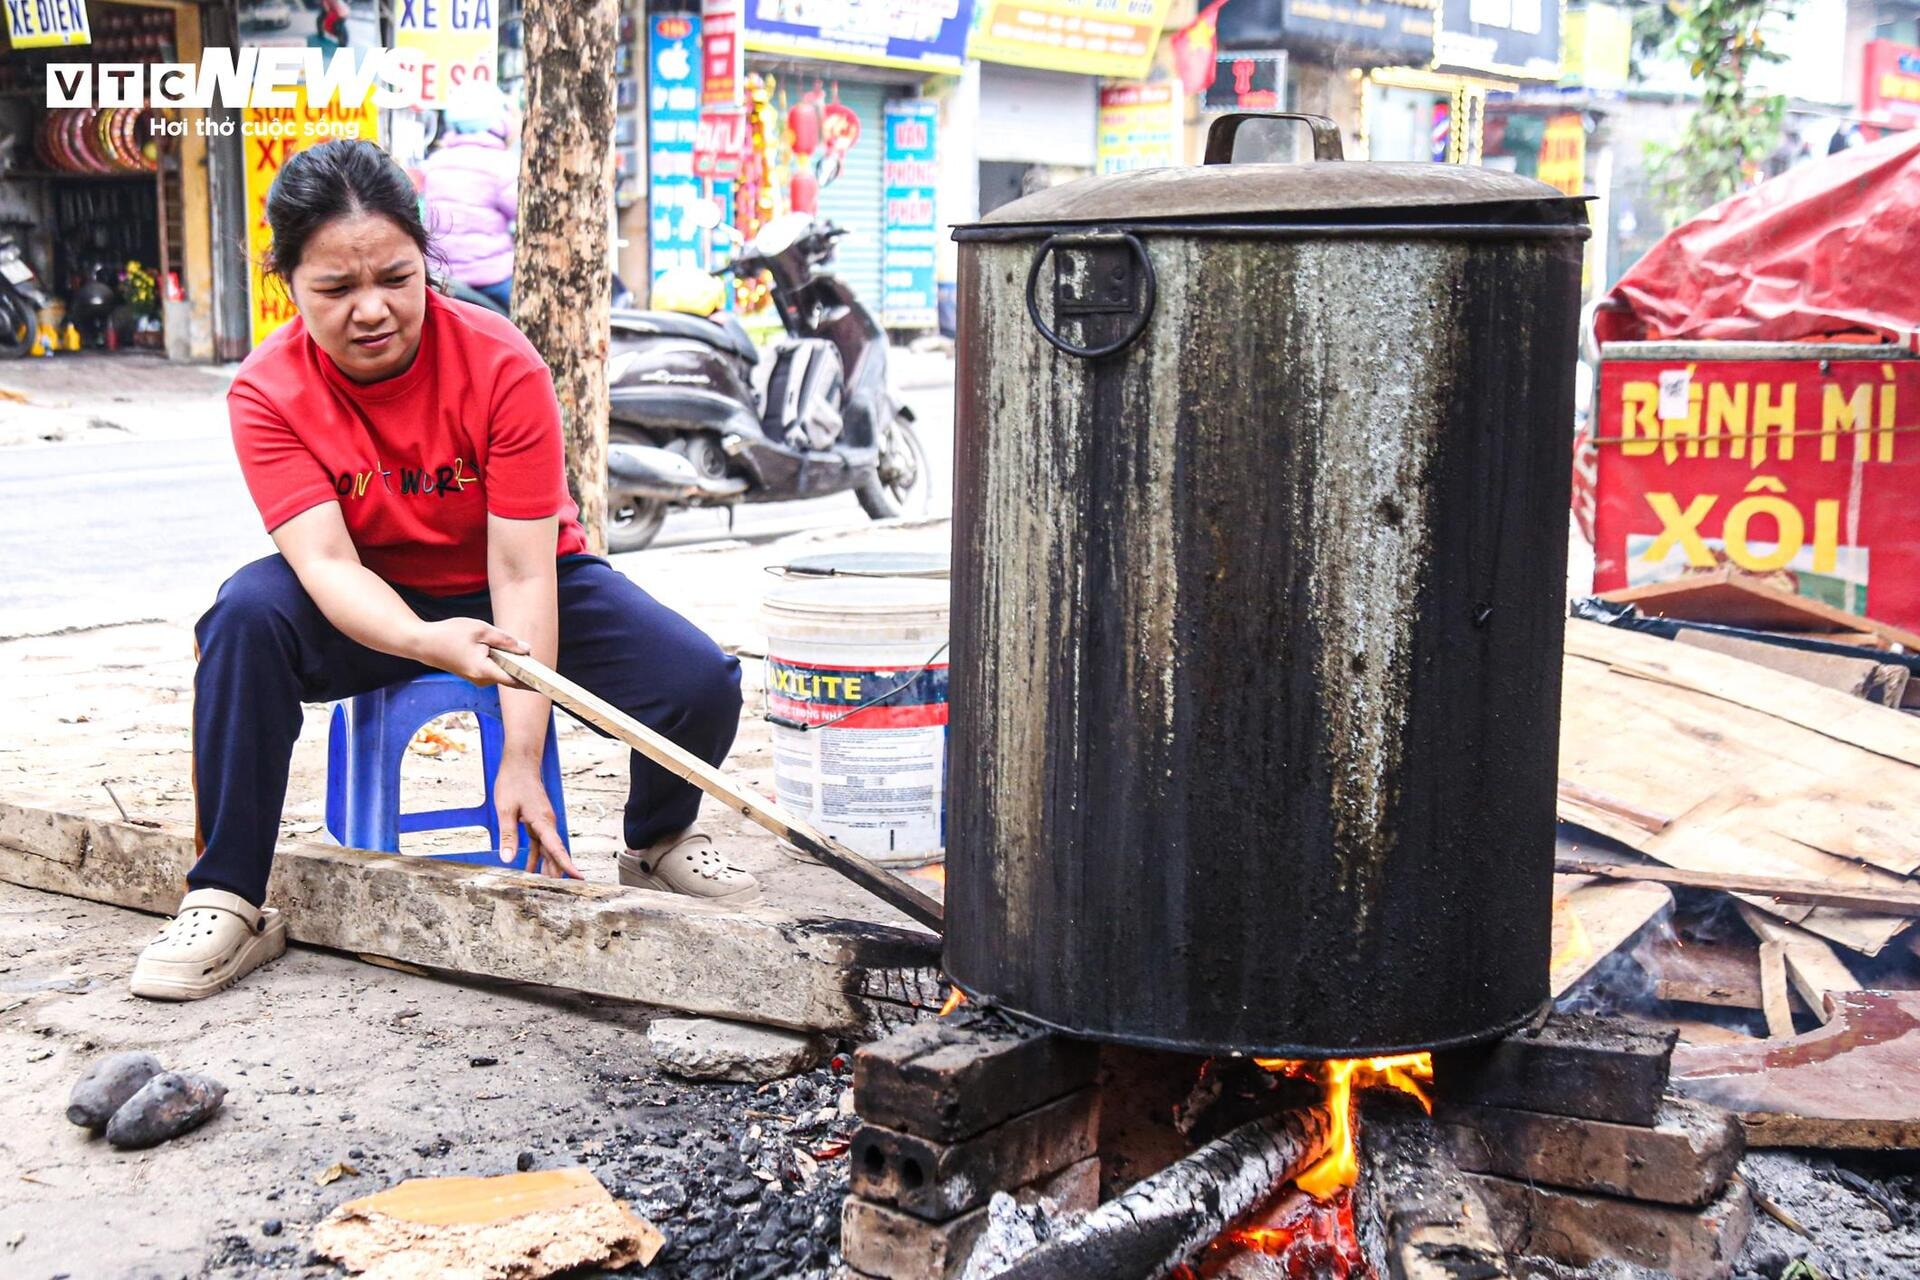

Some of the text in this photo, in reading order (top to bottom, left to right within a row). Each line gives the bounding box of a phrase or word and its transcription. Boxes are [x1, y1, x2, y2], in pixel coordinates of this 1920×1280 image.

[401, 0, 491, 29] XE GA
[1621, 363, 1896, 469] BÁNH MÌ
[1641, 475, 1840, 573] XÔI
